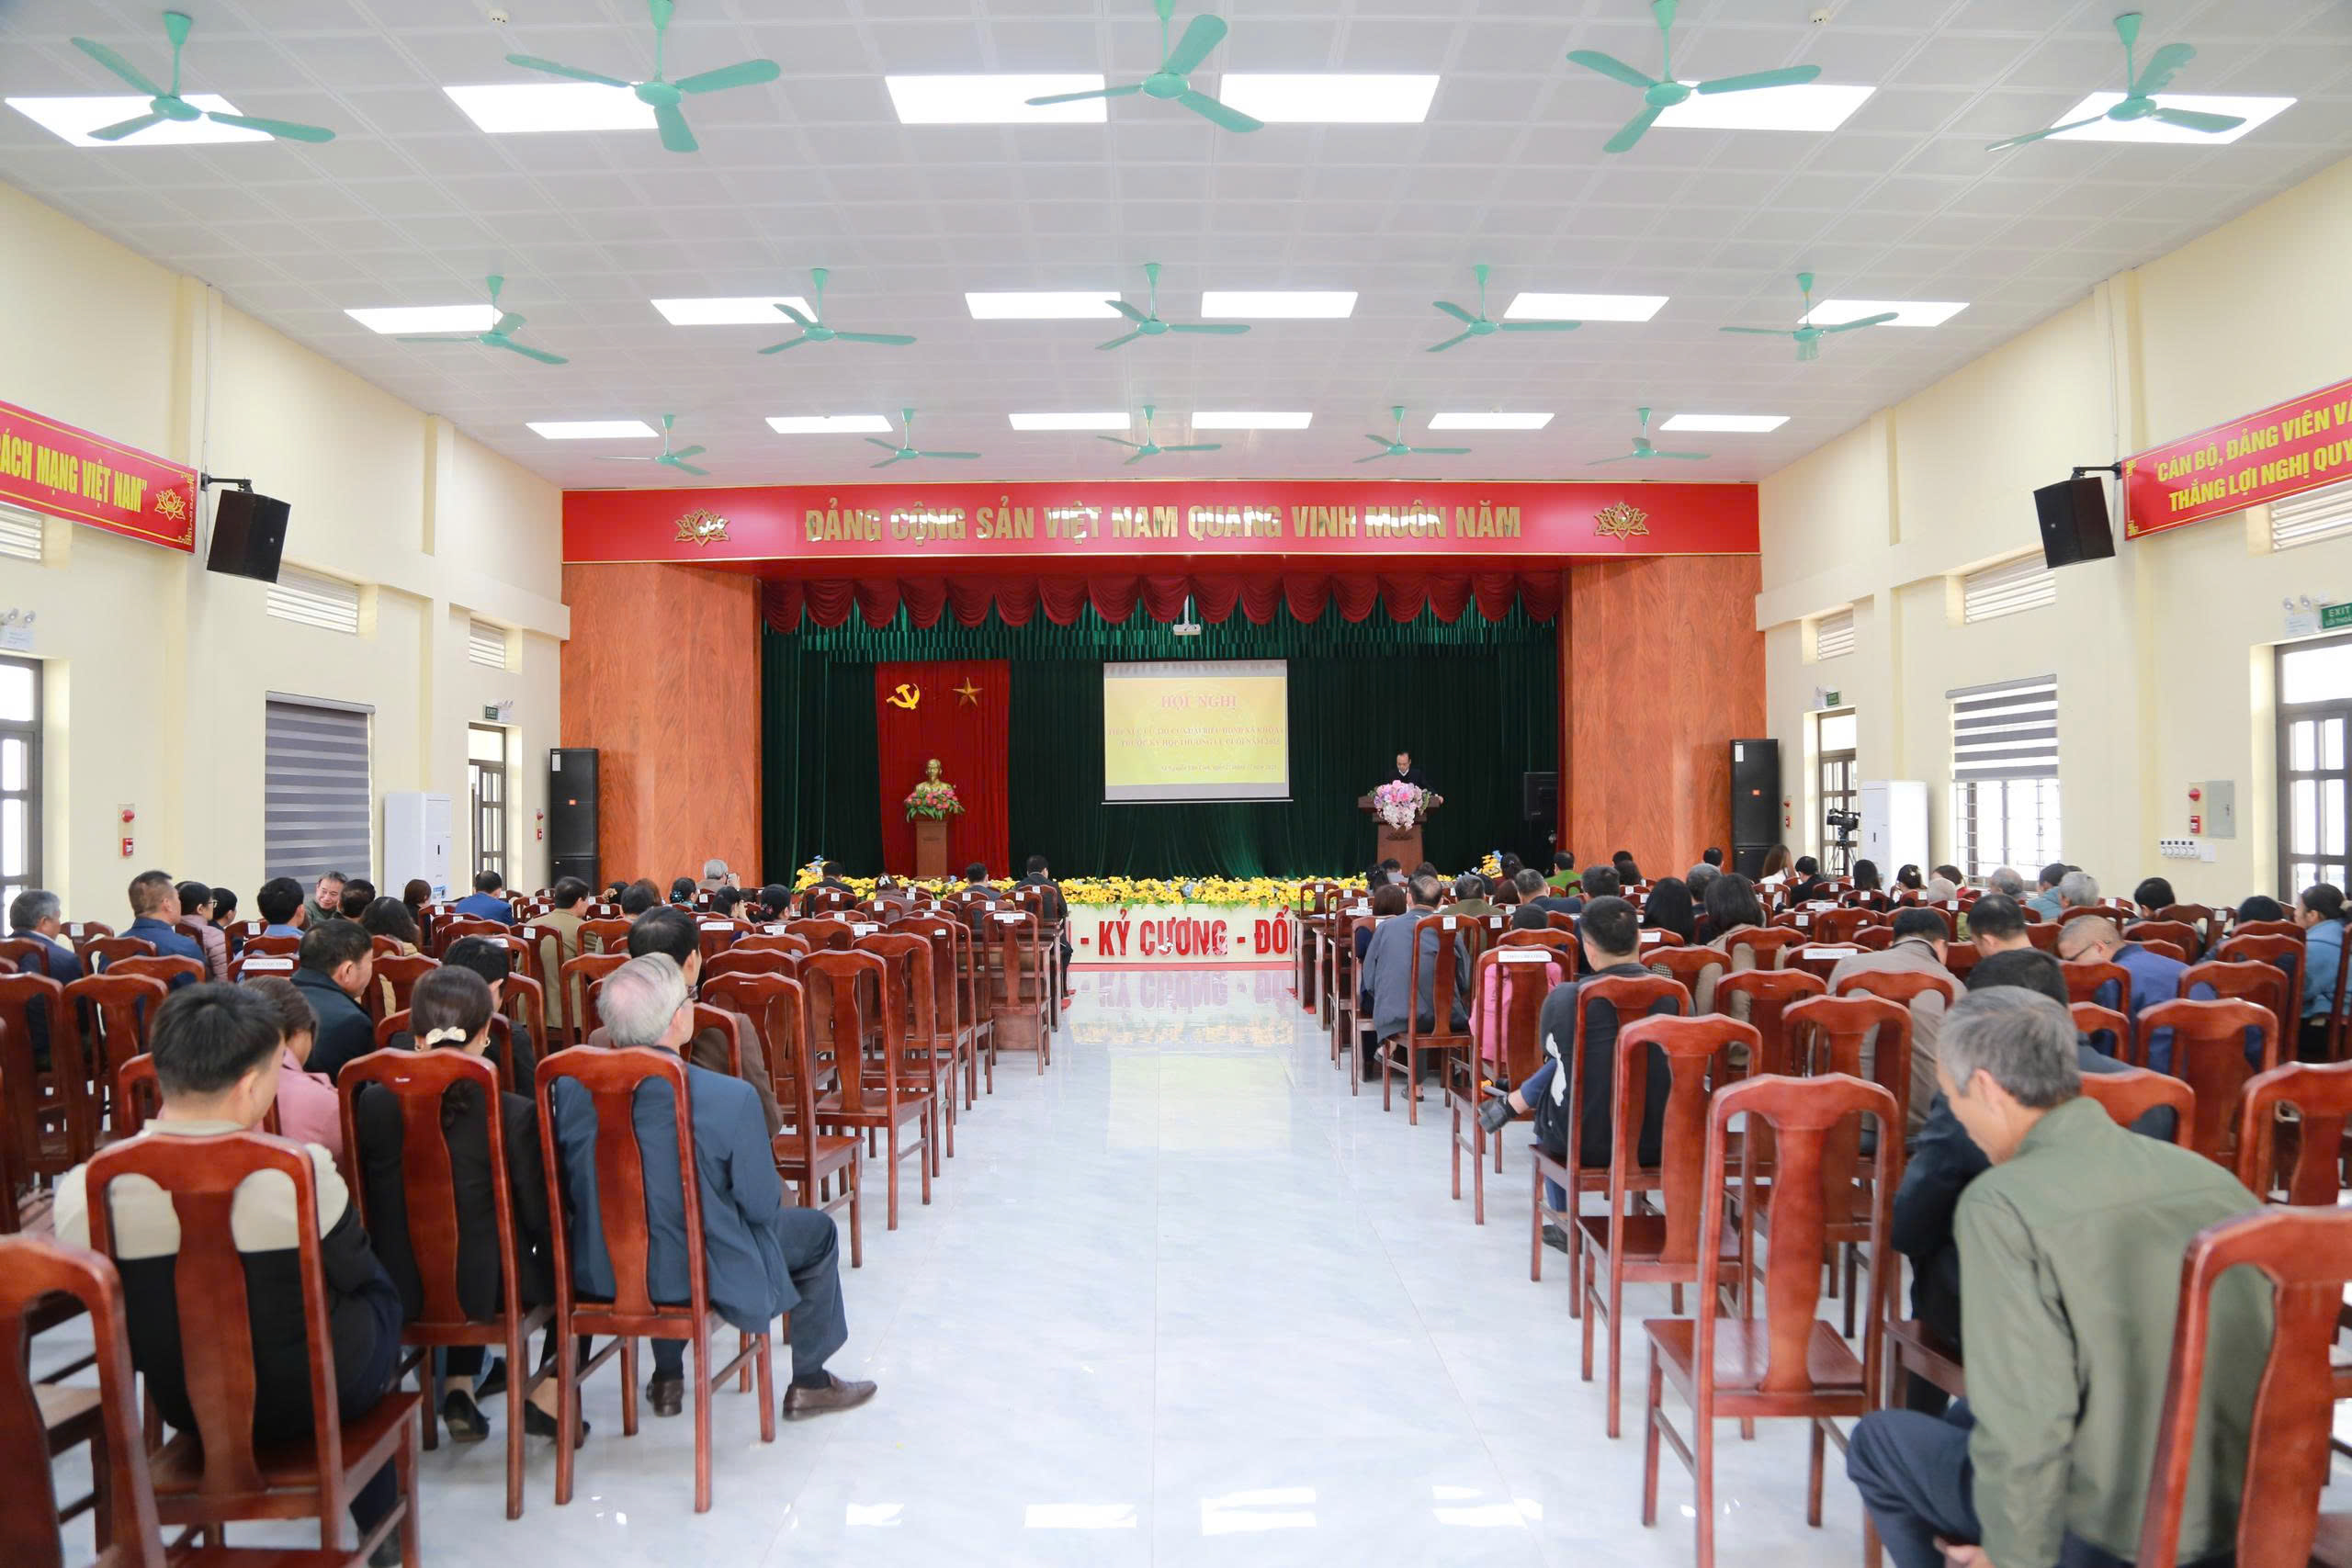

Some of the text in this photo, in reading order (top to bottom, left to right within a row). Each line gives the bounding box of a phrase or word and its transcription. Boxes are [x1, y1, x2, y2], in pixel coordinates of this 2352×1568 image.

[0, 428, 32, 480] ÁCH
[37, 445, 78, 494] MẠNG
[83, 458, 111, 507] VIỆT
[2156, 453, 2192, 482] CÁN
[2195, 442, 2224, 471] BỘ,
[2225, 428, 2279, 460] ĐẢNG
[2281, 407, 2330, 442] VIÊN
[2169, 478, 2227, 512] THẮNG
[2229, 467, 2258, 495] LỢI
[2261, 452, 2311, 485] NGHỊ
[806, 496, 1521, 546] ĐẢNG CỘNG SẢN VIỆT NAM QUANG VINH MUÔN NĂM
[2329, 606, 2350, 617] EXIT
[1099, 908, 1131, 956] KỶ
[1139, 917, 1227, 956] CƯƠNG
